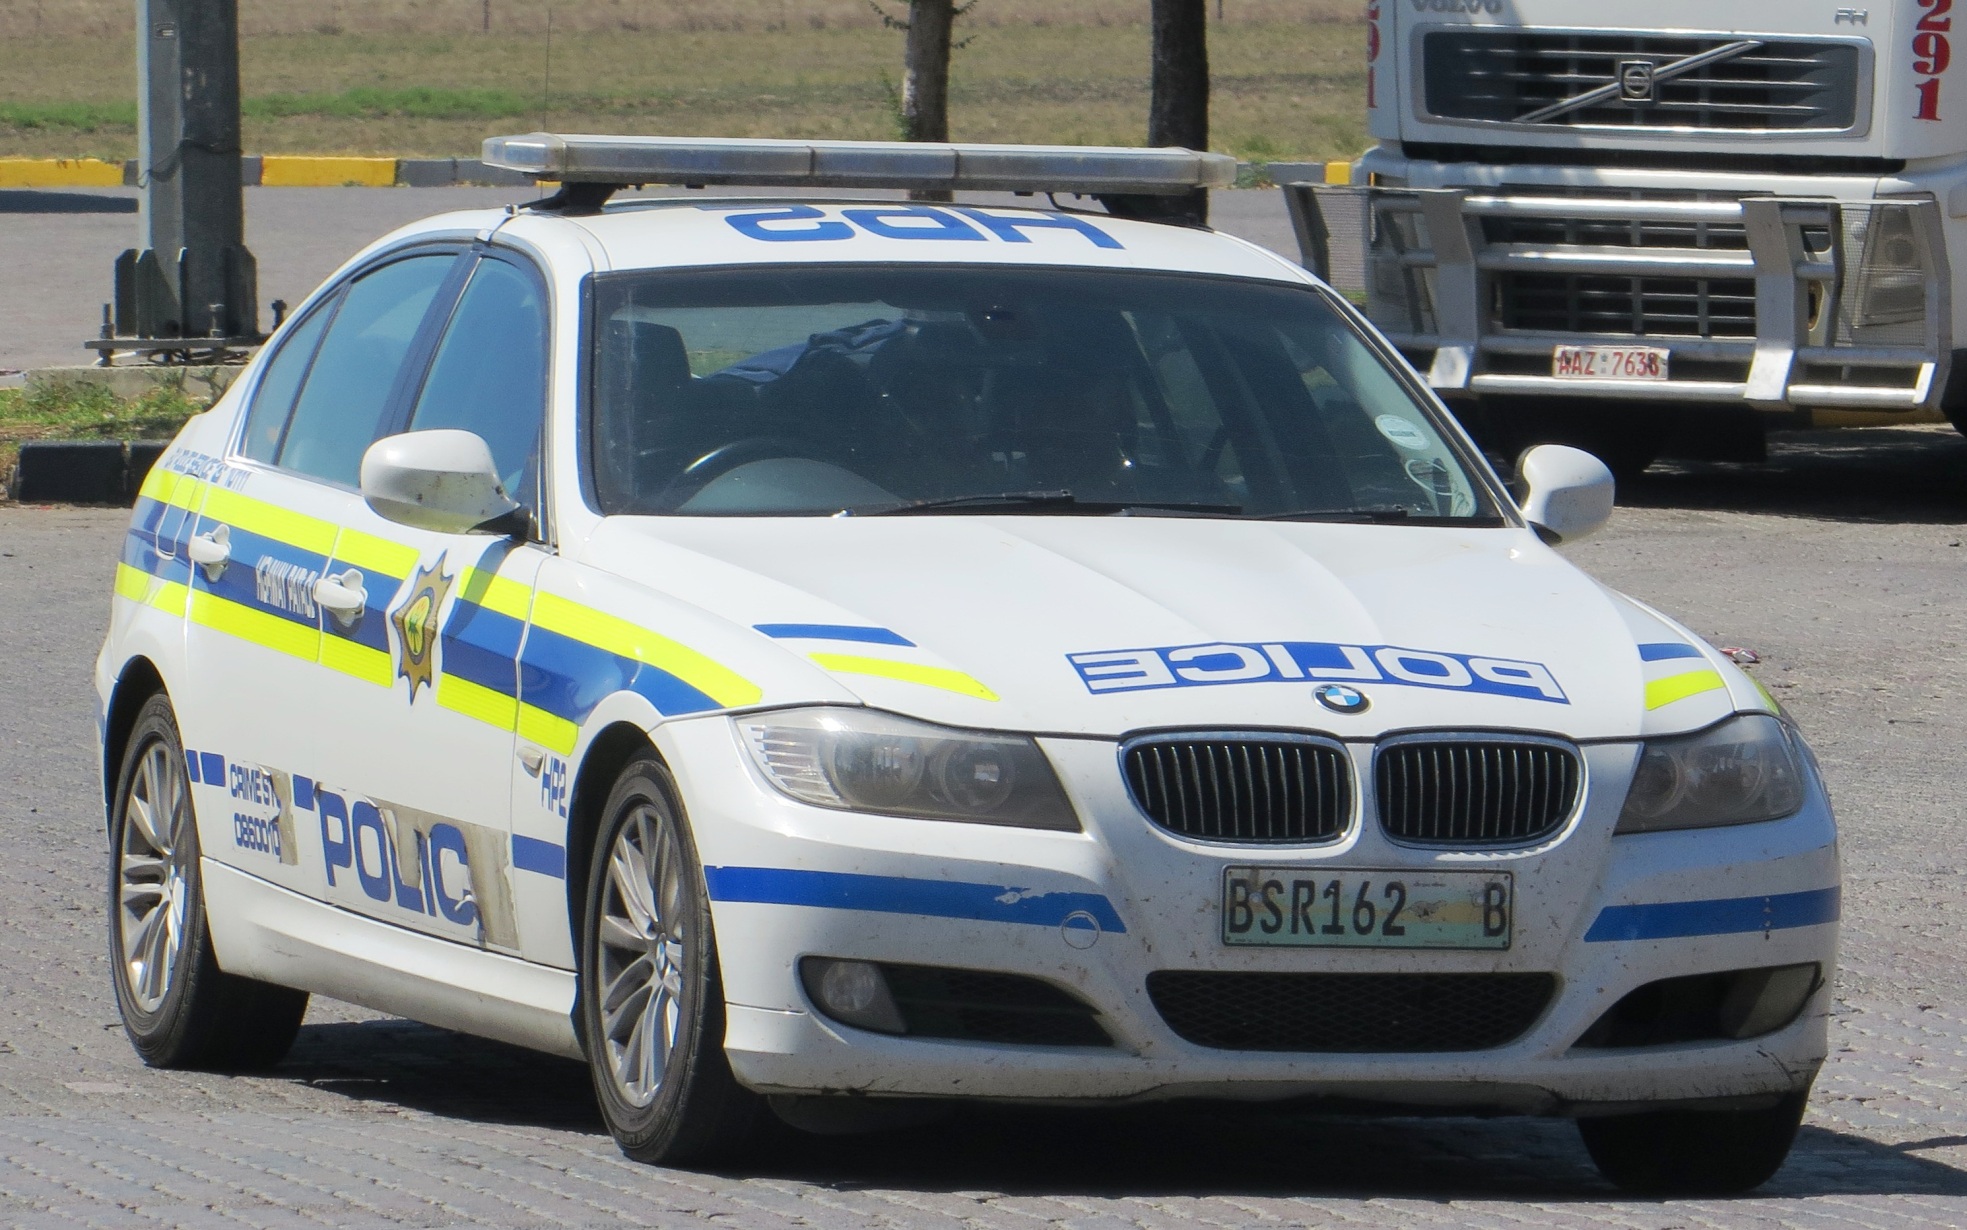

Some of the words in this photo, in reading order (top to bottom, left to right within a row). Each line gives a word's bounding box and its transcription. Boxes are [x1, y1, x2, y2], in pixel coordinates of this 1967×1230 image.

[1559, 349, 1596, 375] AAZ
[230, 763, 262, 804] CRIME
[541, 753, 567, 818] HP2
[1483, 881, 1508, 937] B
